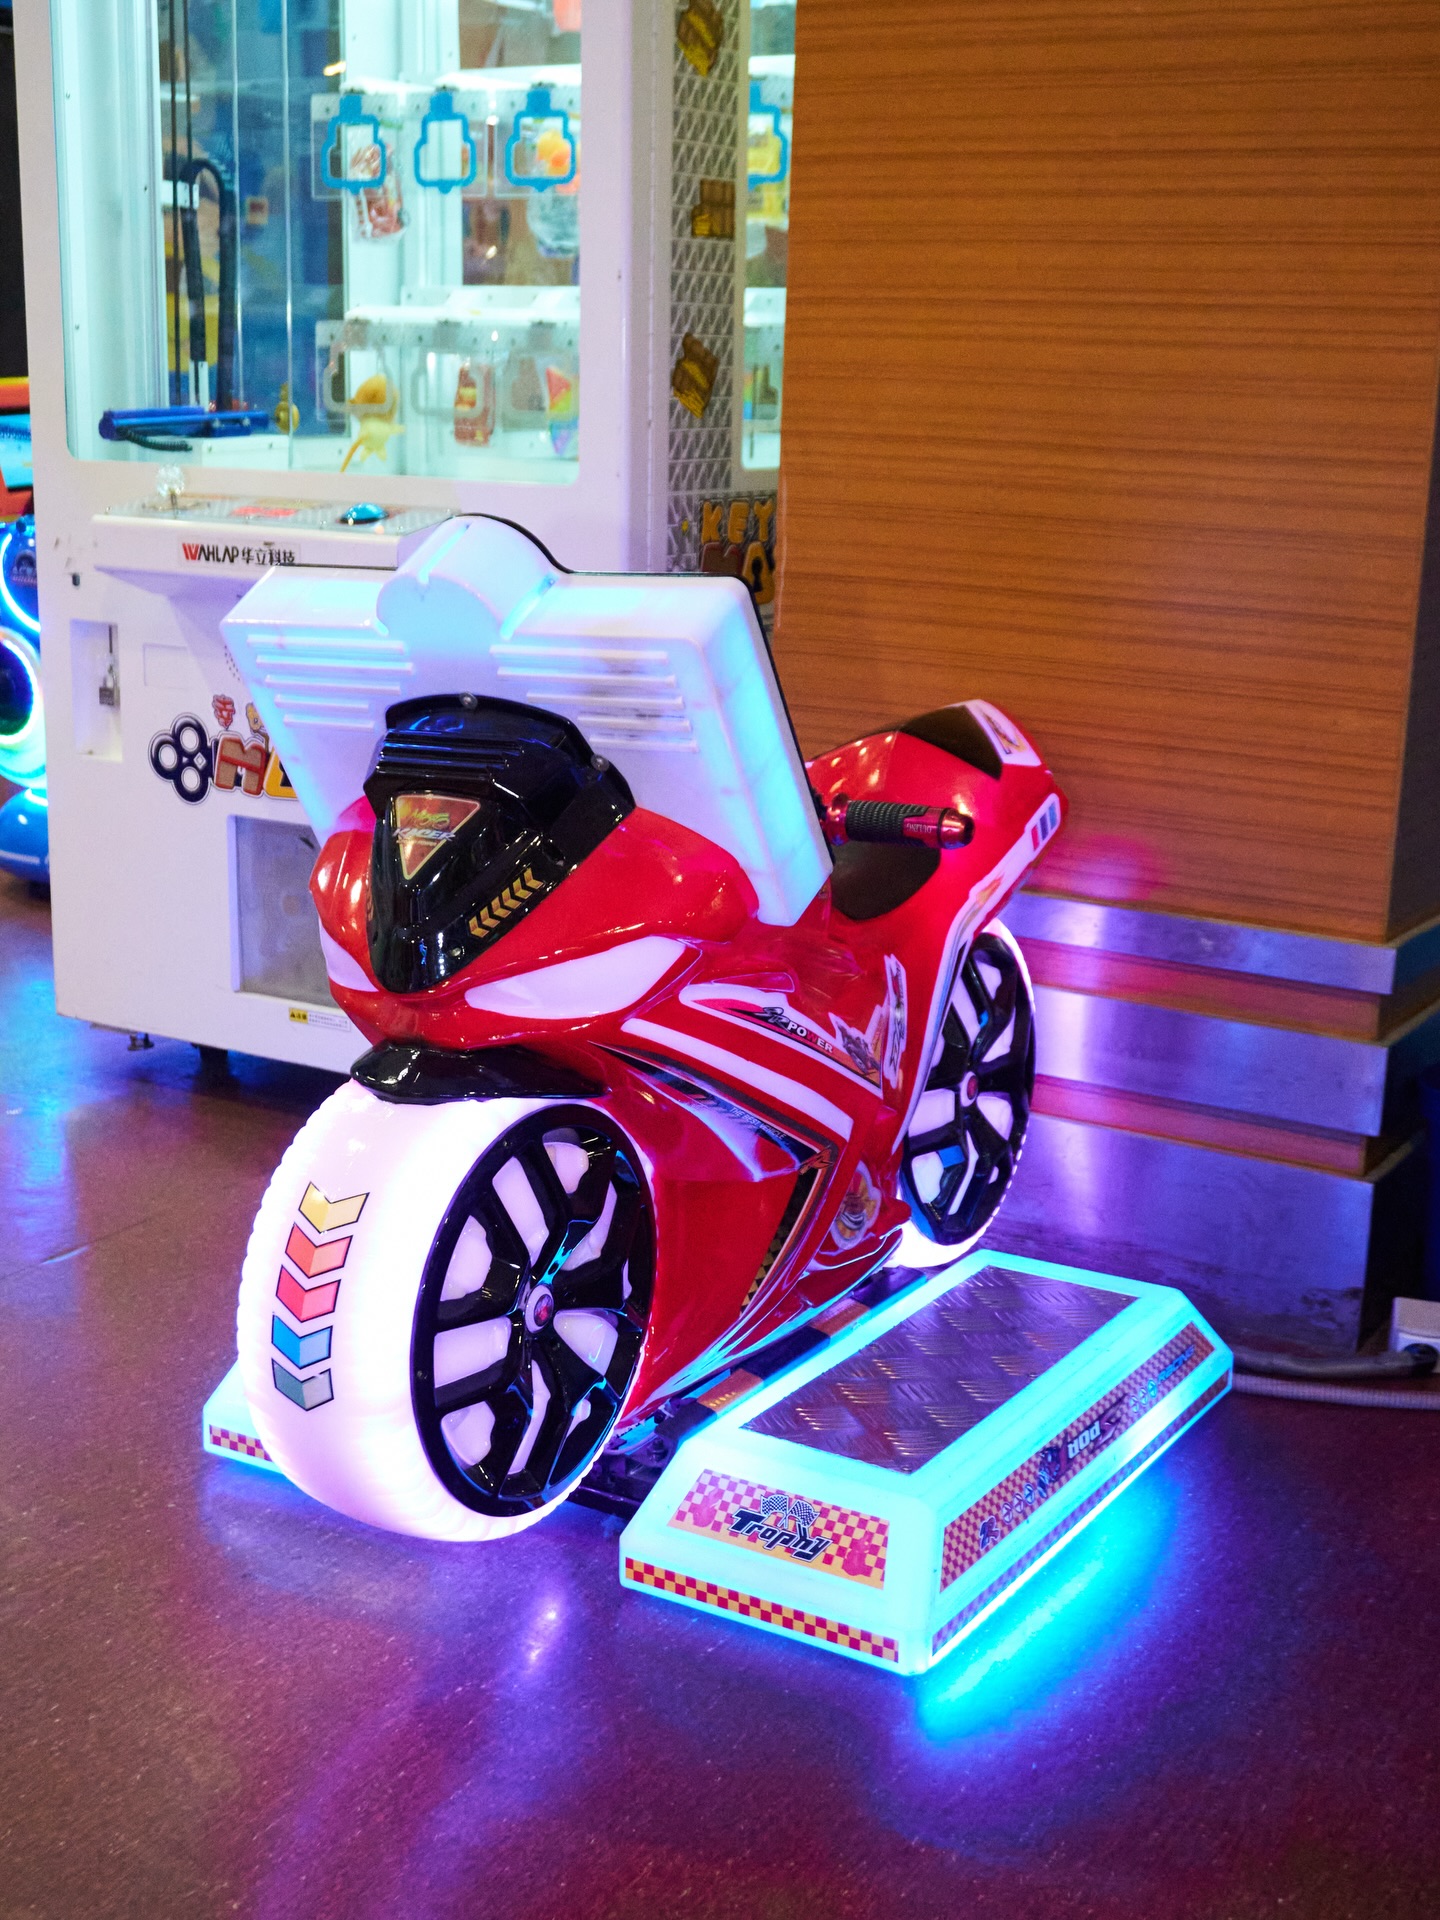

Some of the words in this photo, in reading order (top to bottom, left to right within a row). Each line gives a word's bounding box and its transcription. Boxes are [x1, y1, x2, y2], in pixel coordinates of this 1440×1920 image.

[701, 499, 773, 545] KEY
[182, 543, 239, 563] WAHLAP
[241, 546, 295, 565] 华立科技
[787, 1020, 833, 1053] POWER
[742, 1113, 761, 1127] BEST
[728, 1508, 833, 1562] Trophy
